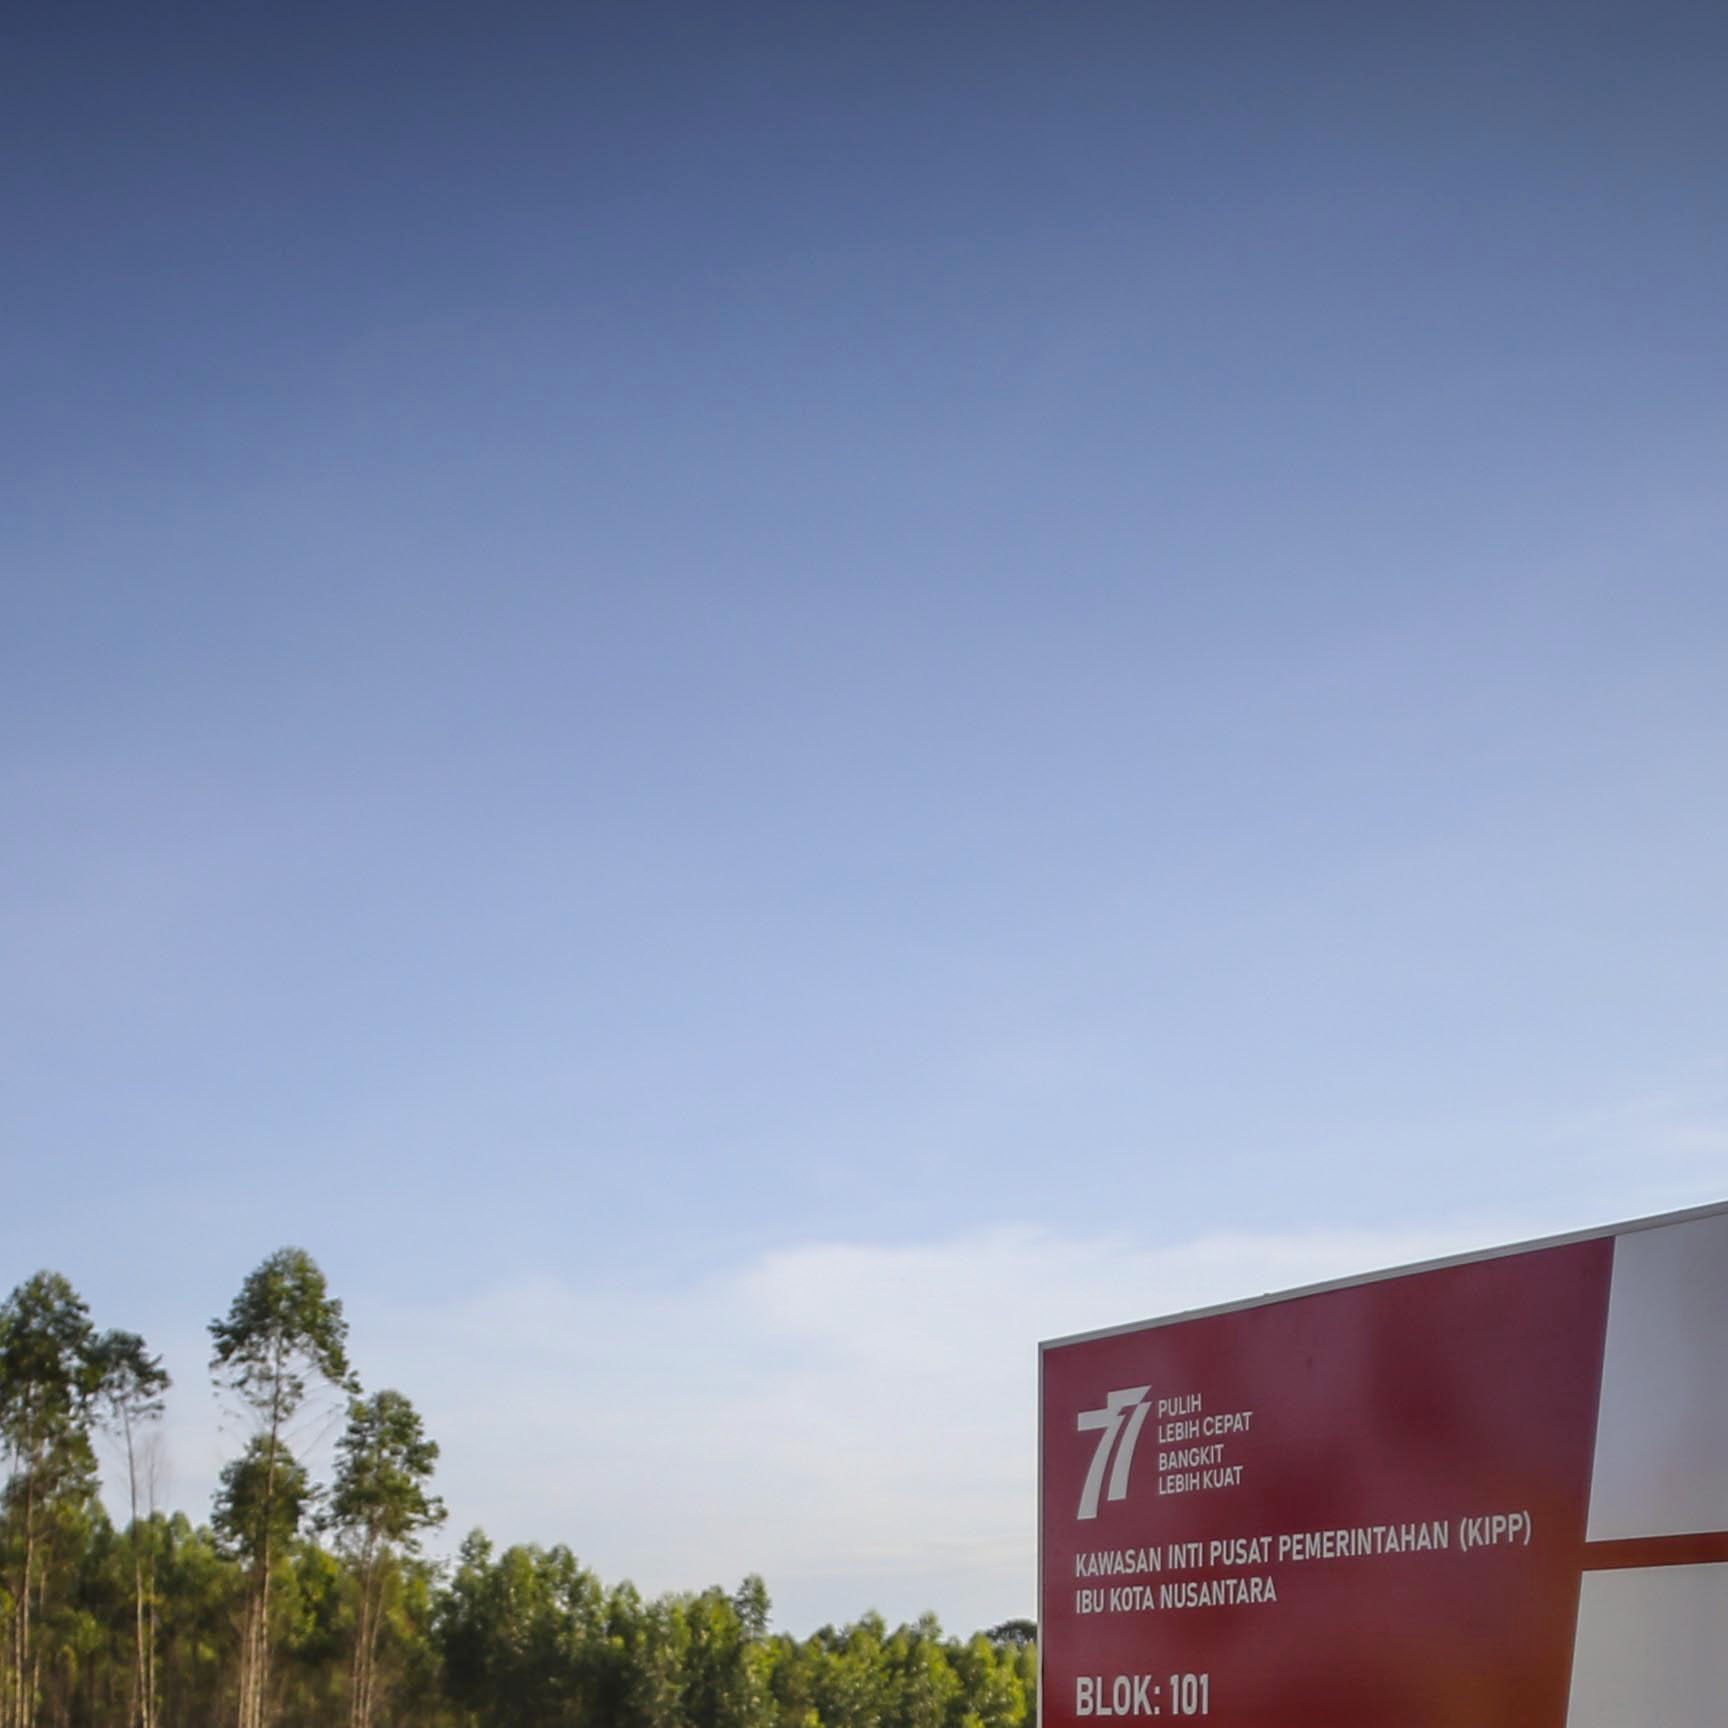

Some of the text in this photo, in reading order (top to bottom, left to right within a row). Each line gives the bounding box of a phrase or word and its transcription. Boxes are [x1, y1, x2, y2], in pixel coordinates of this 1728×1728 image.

[1158, 1393, 1202, 1419] PULIH
[1158, 1412, 1253, 1444] LEBIH CEPAT
[1159, 1444, 1225, 1471] BANGKIT
[1159, 1466, 1243, 1495] LEBIH KUAT
[1075, 1511, 1532, 1577] KAWASAN INTI PUSAT PEMERINTAHAN (KIPP)
[1075, 1576, 1278, 1614] IBU KOTA NUSANTARA
[1075, 1673, 1210, 1716] BLOK: 101
